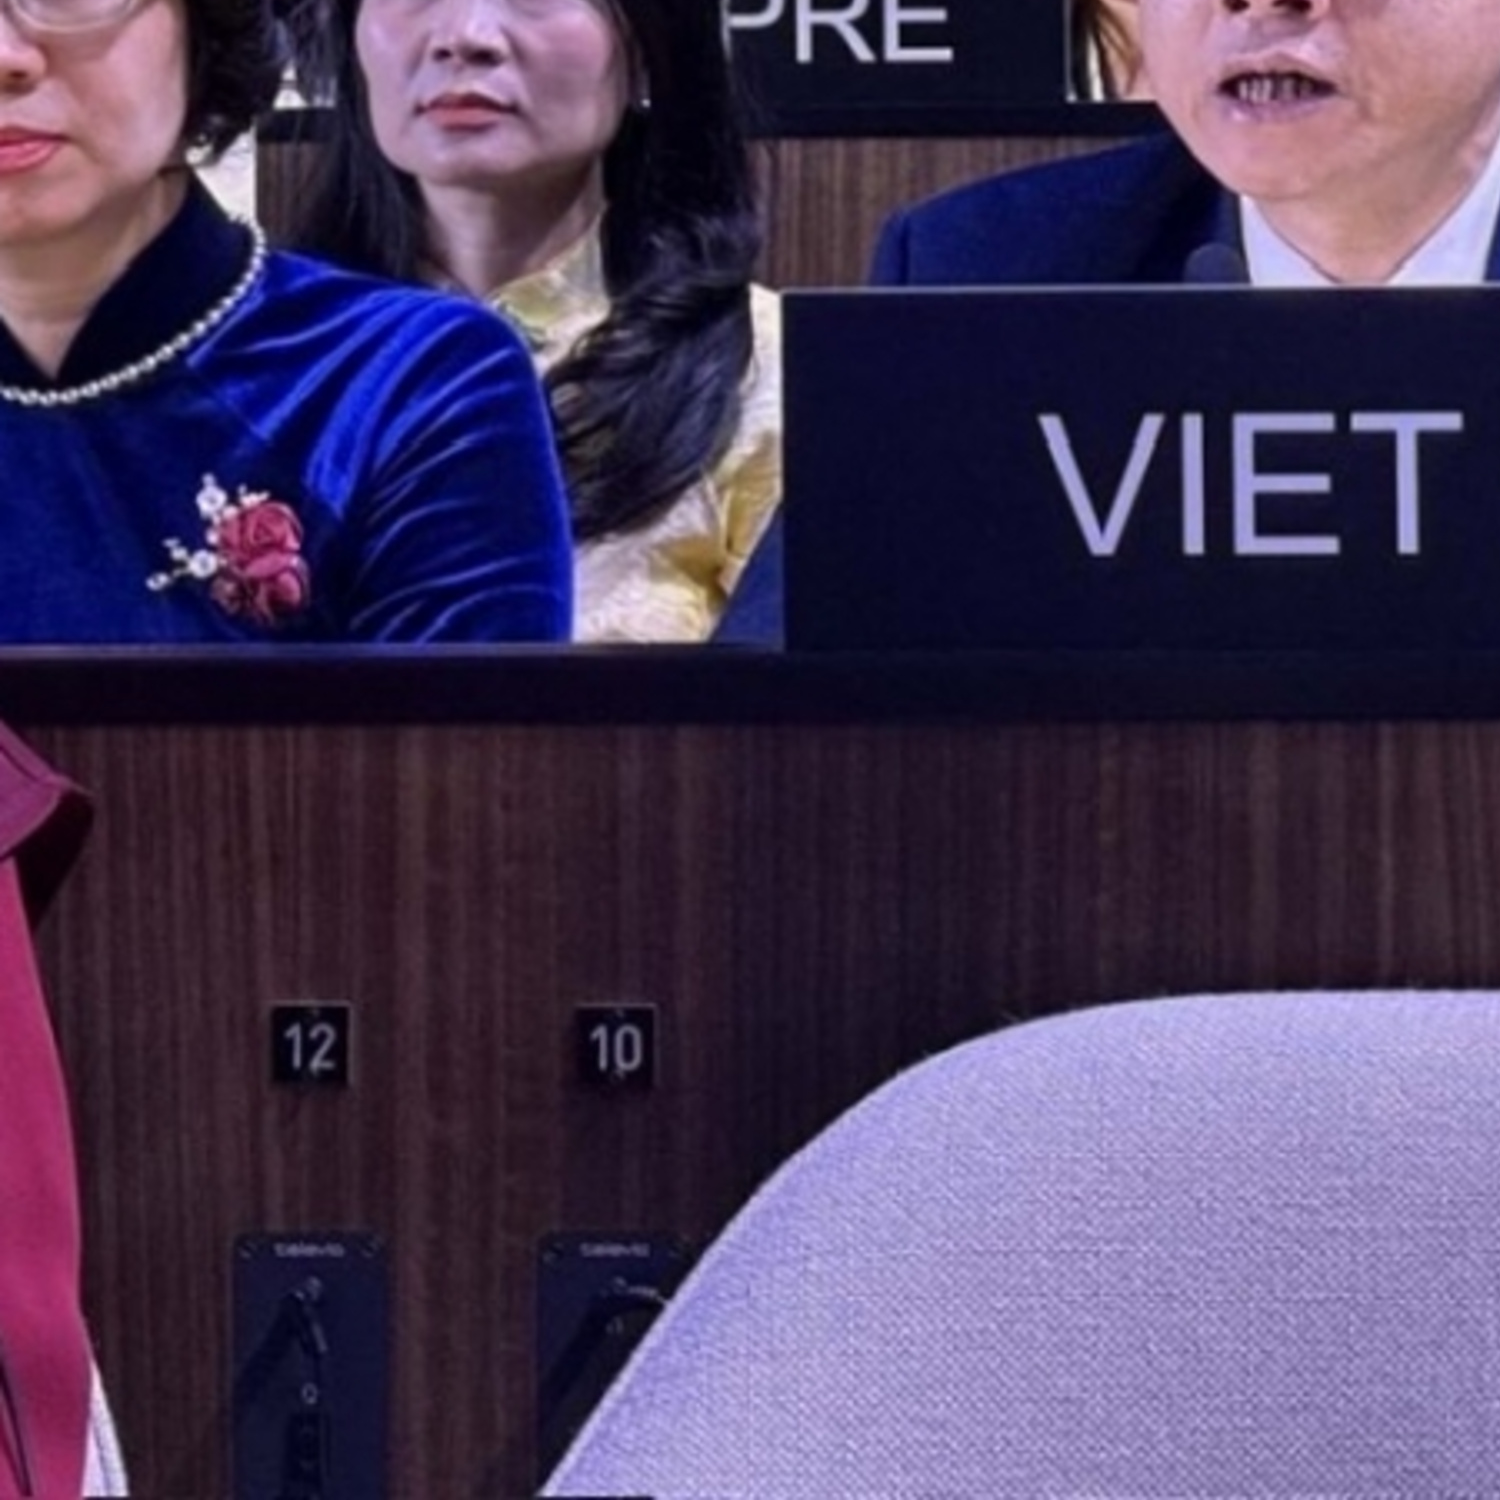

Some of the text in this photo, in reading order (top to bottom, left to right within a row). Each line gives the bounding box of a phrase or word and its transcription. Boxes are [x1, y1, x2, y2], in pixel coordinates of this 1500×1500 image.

[1038, 411, 1464, 555] VIET
[284, 1023, 336, 1071] 12
[589, 1024, 643, 1072] 10
